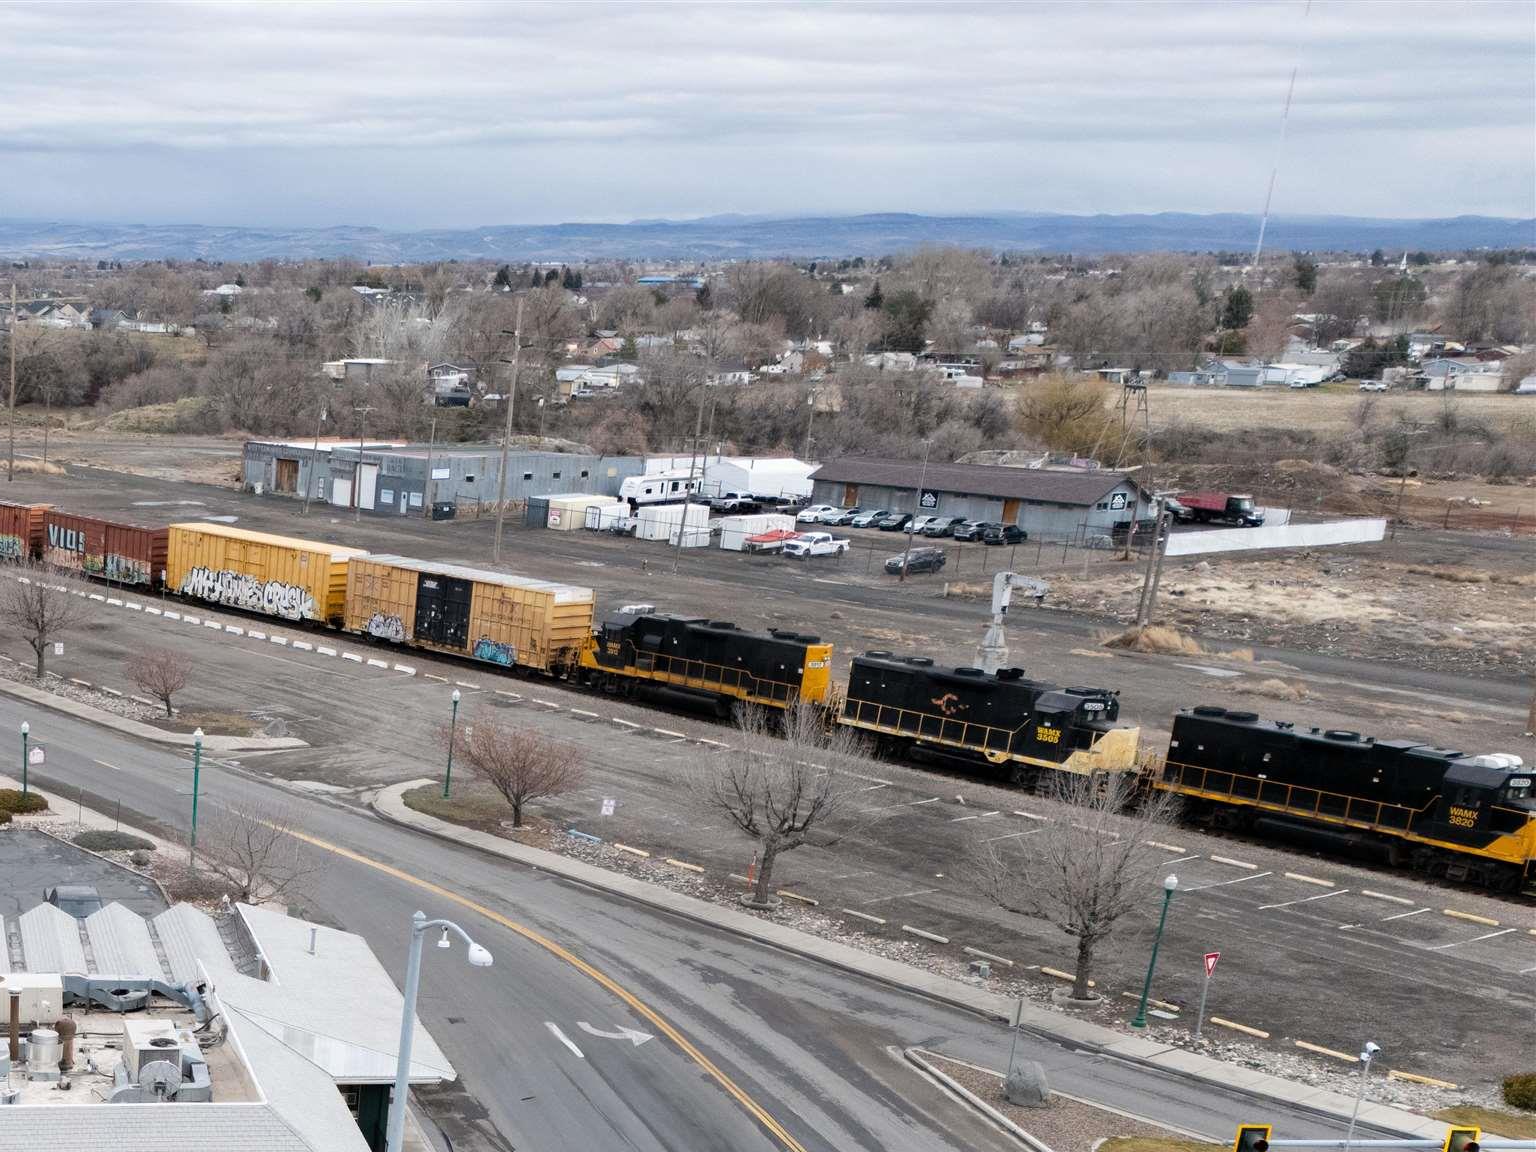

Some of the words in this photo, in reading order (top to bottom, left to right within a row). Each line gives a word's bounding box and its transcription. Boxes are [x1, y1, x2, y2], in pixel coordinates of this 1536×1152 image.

[1037, 726, 1061, 738] WAMX
[1450, 806, 1479, 819] WAMX
[1449, 815, 1474, 828] 3820
